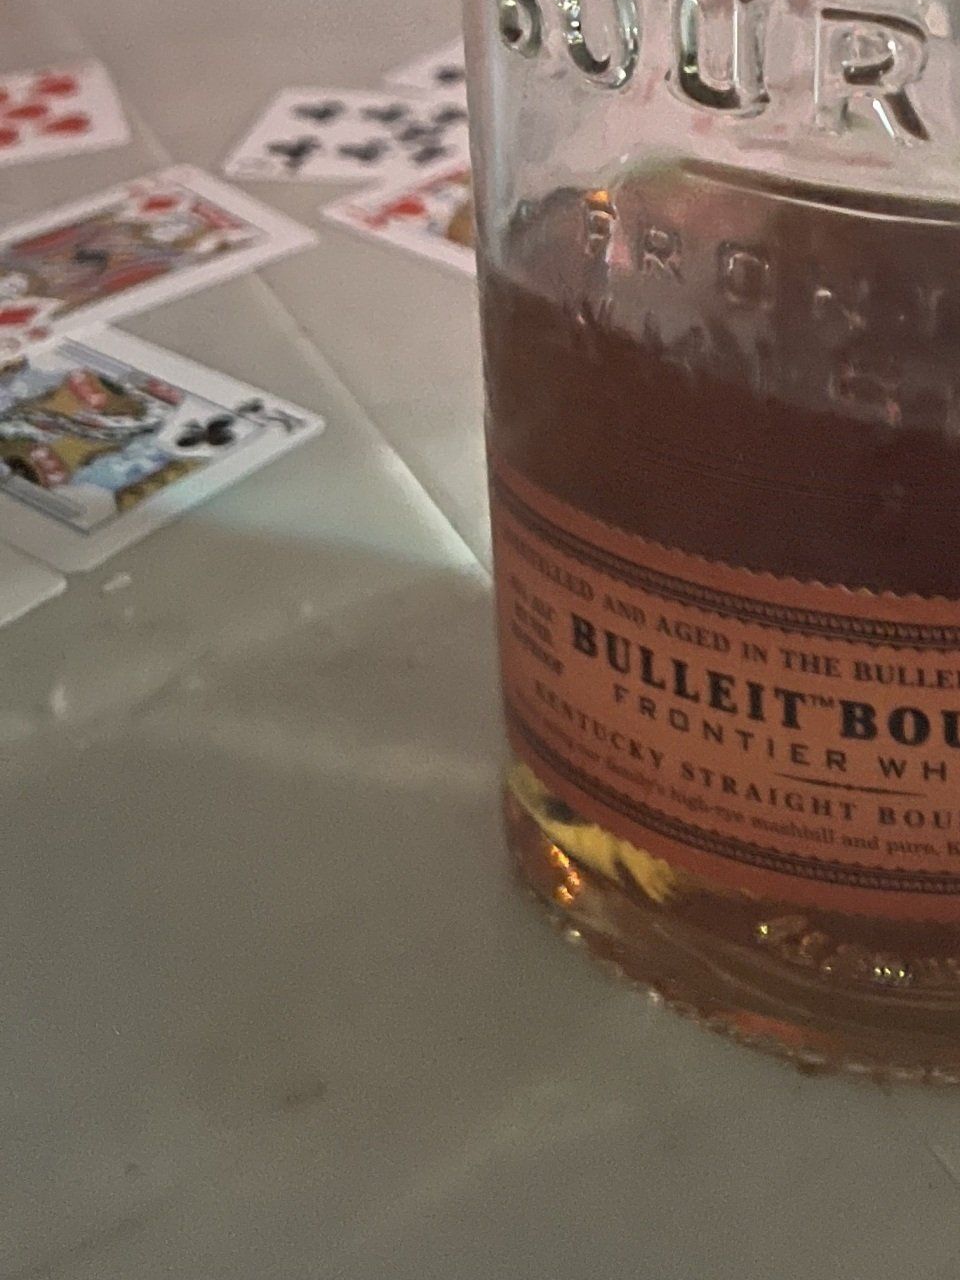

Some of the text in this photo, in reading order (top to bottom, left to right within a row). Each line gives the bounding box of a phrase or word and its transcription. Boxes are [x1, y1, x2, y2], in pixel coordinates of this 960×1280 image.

[571, 611, 806, 731] BULLEIT
[603, 592, 646, 626] AND
[658, 615, 731, 653] AGED
[742, 641, 767, 664] IN
[779, 648, 841, 678] THE
[534, 679, 664, 771] KENTUCKY
[681, 761, 857, 821] STRAIGHT
[612, 682, 848, 772] FRONTIER
[842, 834, 880, 851] and
